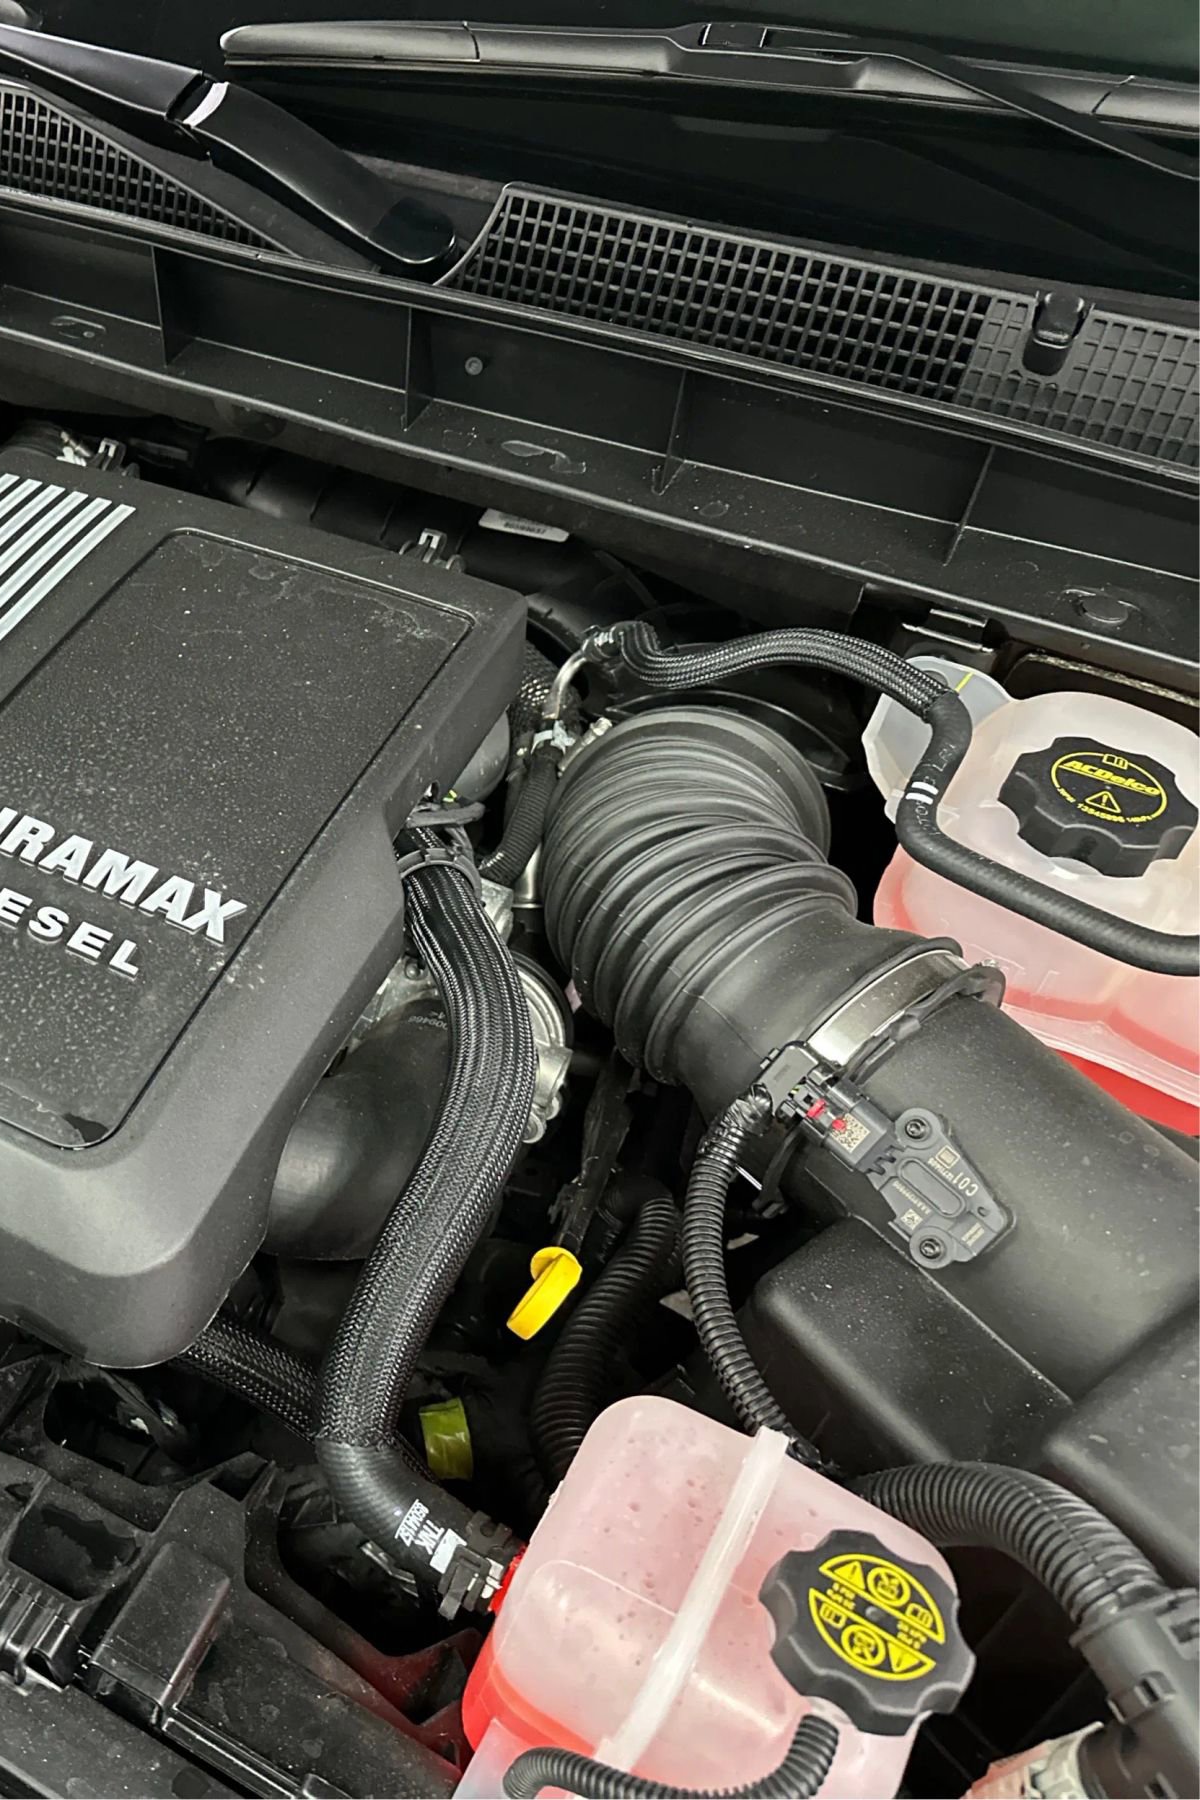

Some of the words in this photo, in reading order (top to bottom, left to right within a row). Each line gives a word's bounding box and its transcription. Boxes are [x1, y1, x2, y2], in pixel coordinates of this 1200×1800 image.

[1060, 760, 1162, 796] ACDelco
[952, 1171, 979, 1197] C01
[414, 1519, 445, 1555] TNK
